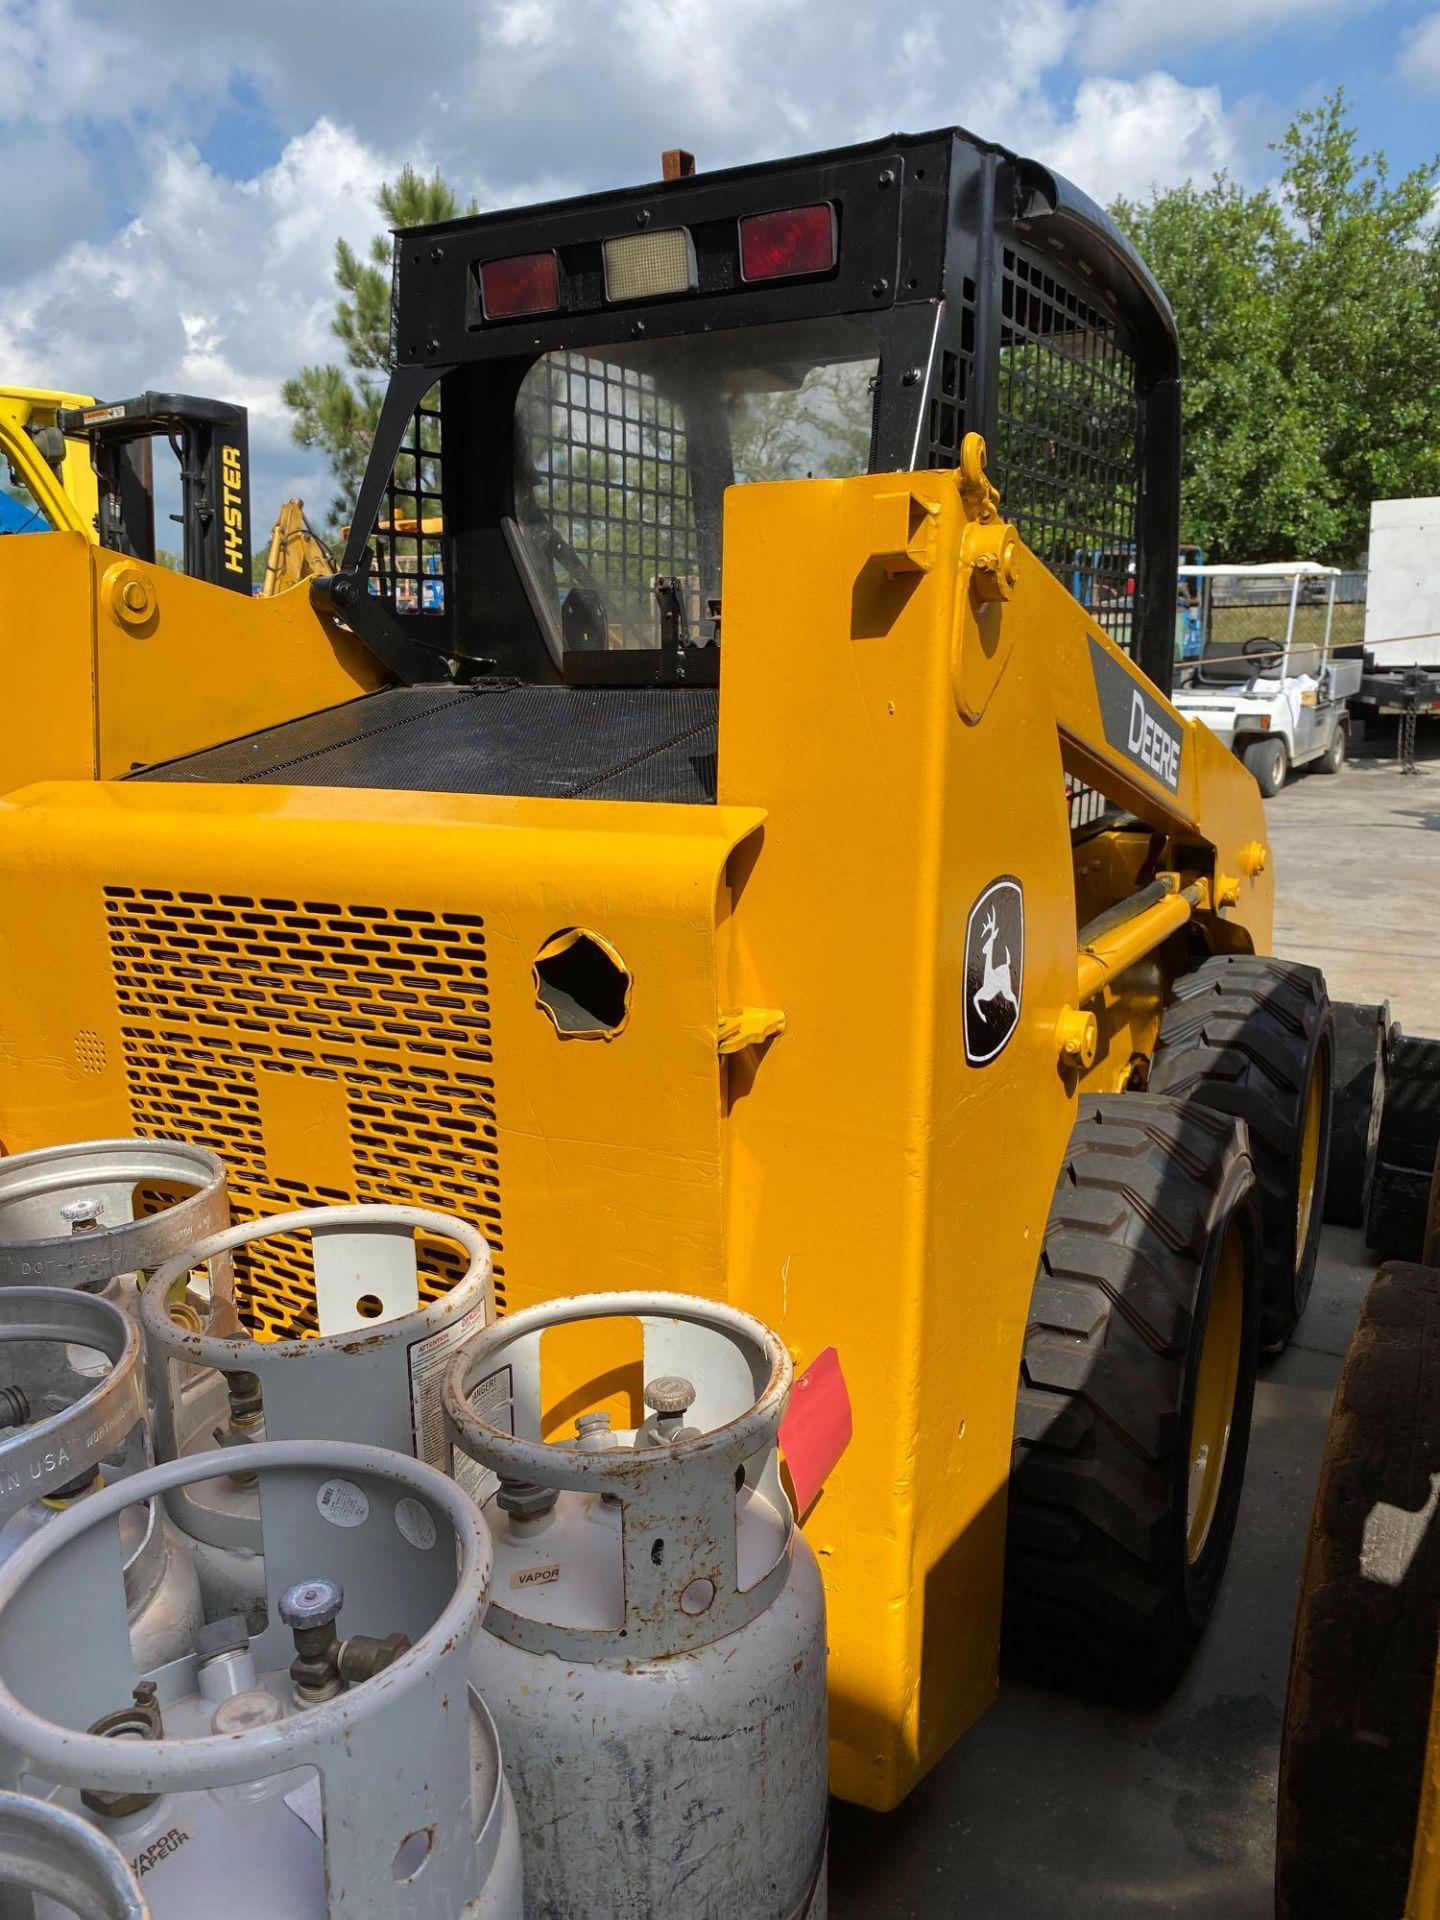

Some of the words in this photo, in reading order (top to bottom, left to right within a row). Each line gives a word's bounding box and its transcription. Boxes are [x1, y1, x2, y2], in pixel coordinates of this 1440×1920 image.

[222, 445, 243, 573] HYSTER
[1127, 688, 1181, 788] DEERE
[472, 1377, 497, 1400] ANGER!
[30, 1446, 69, 1480] USA
[518, 1567, 560, 1584] VAPOR
[130, 1828, 180, 1870] VAPOR
